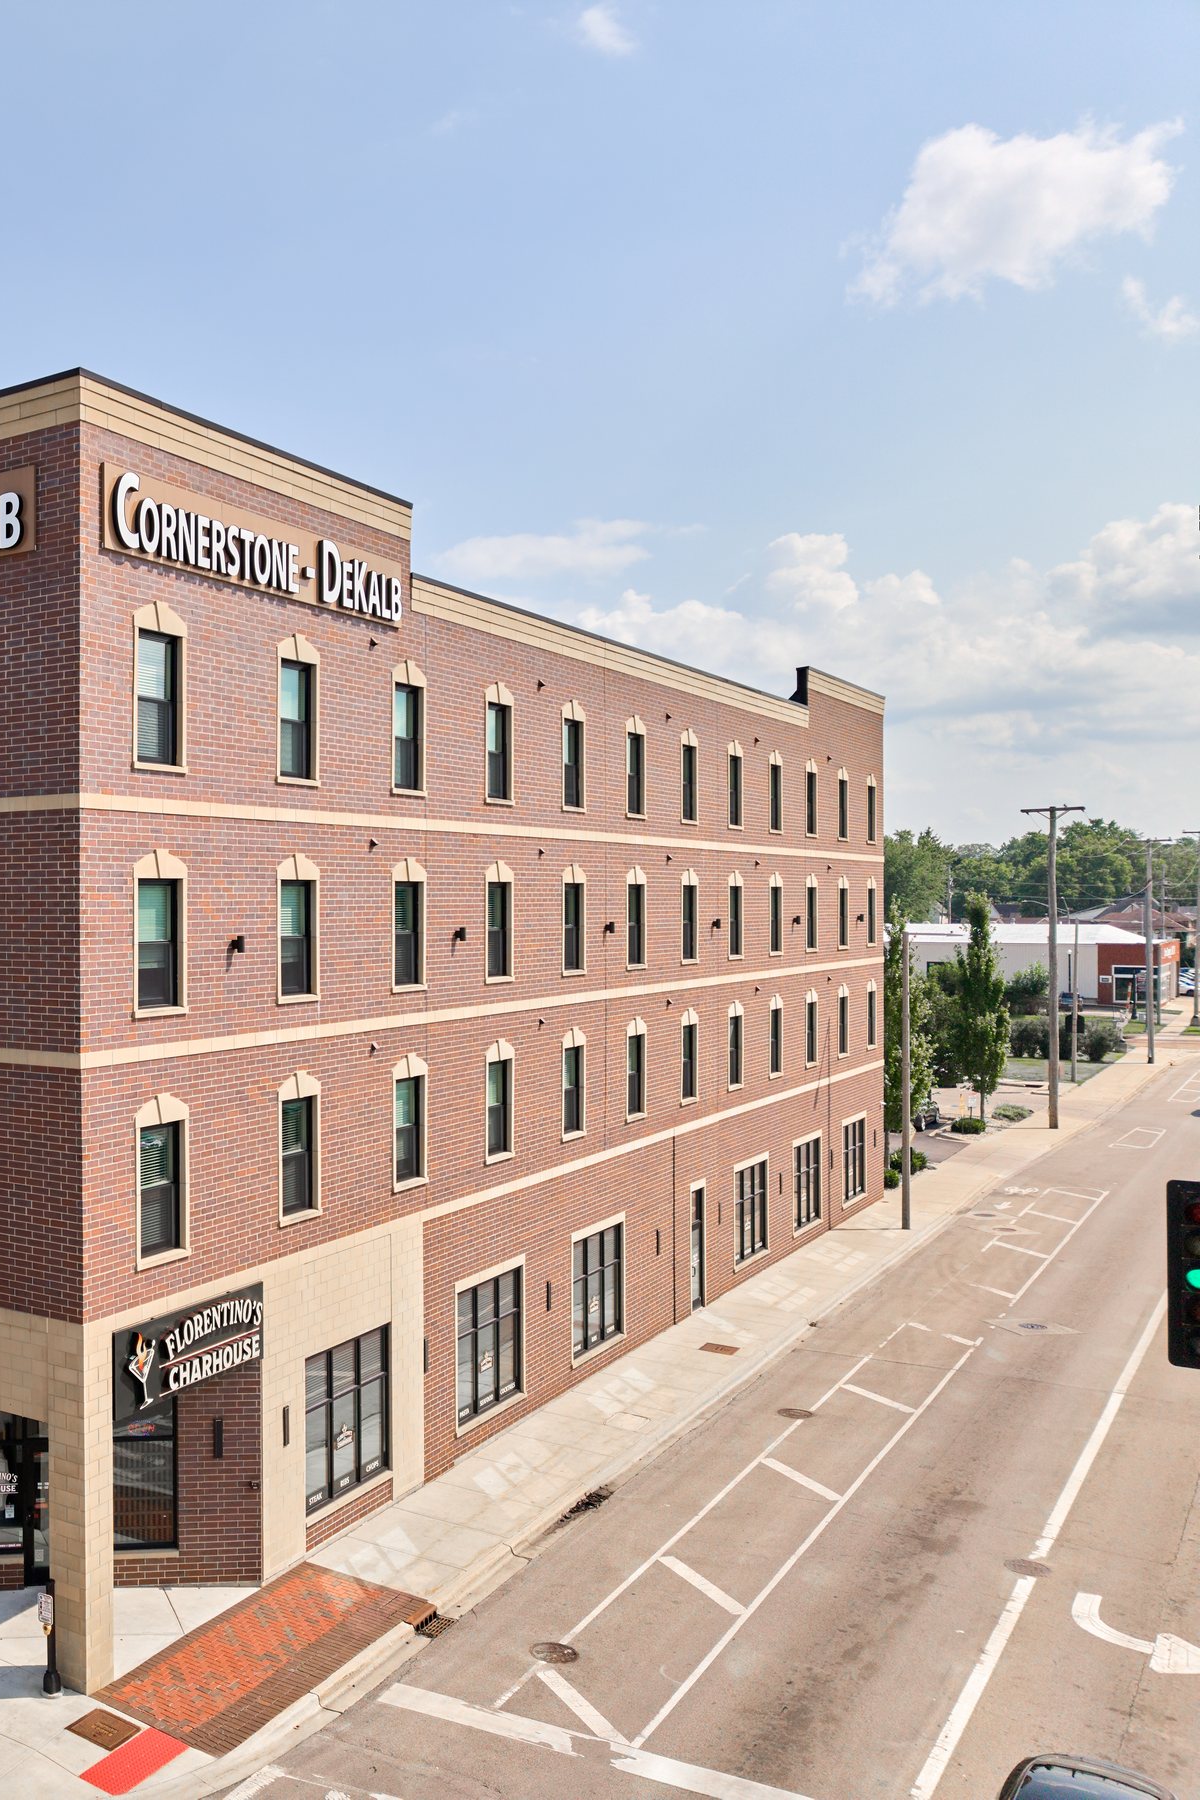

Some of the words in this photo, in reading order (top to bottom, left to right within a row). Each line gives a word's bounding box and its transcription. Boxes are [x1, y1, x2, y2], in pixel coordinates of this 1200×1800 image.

[165, 1298, 263, 1361] FLORENTINO'S
[168, 1334, 261, 1391] CHARHOUSE
[479, 1394, 494, 1406] SEAFOOD
[459, 1407, 470, 1419] PASTA
[365, 1460, 380, 1472] CHOPS
[340, 1477, 350, 1488] RIBS
[308, 1492, 323, 1505] STEAK
